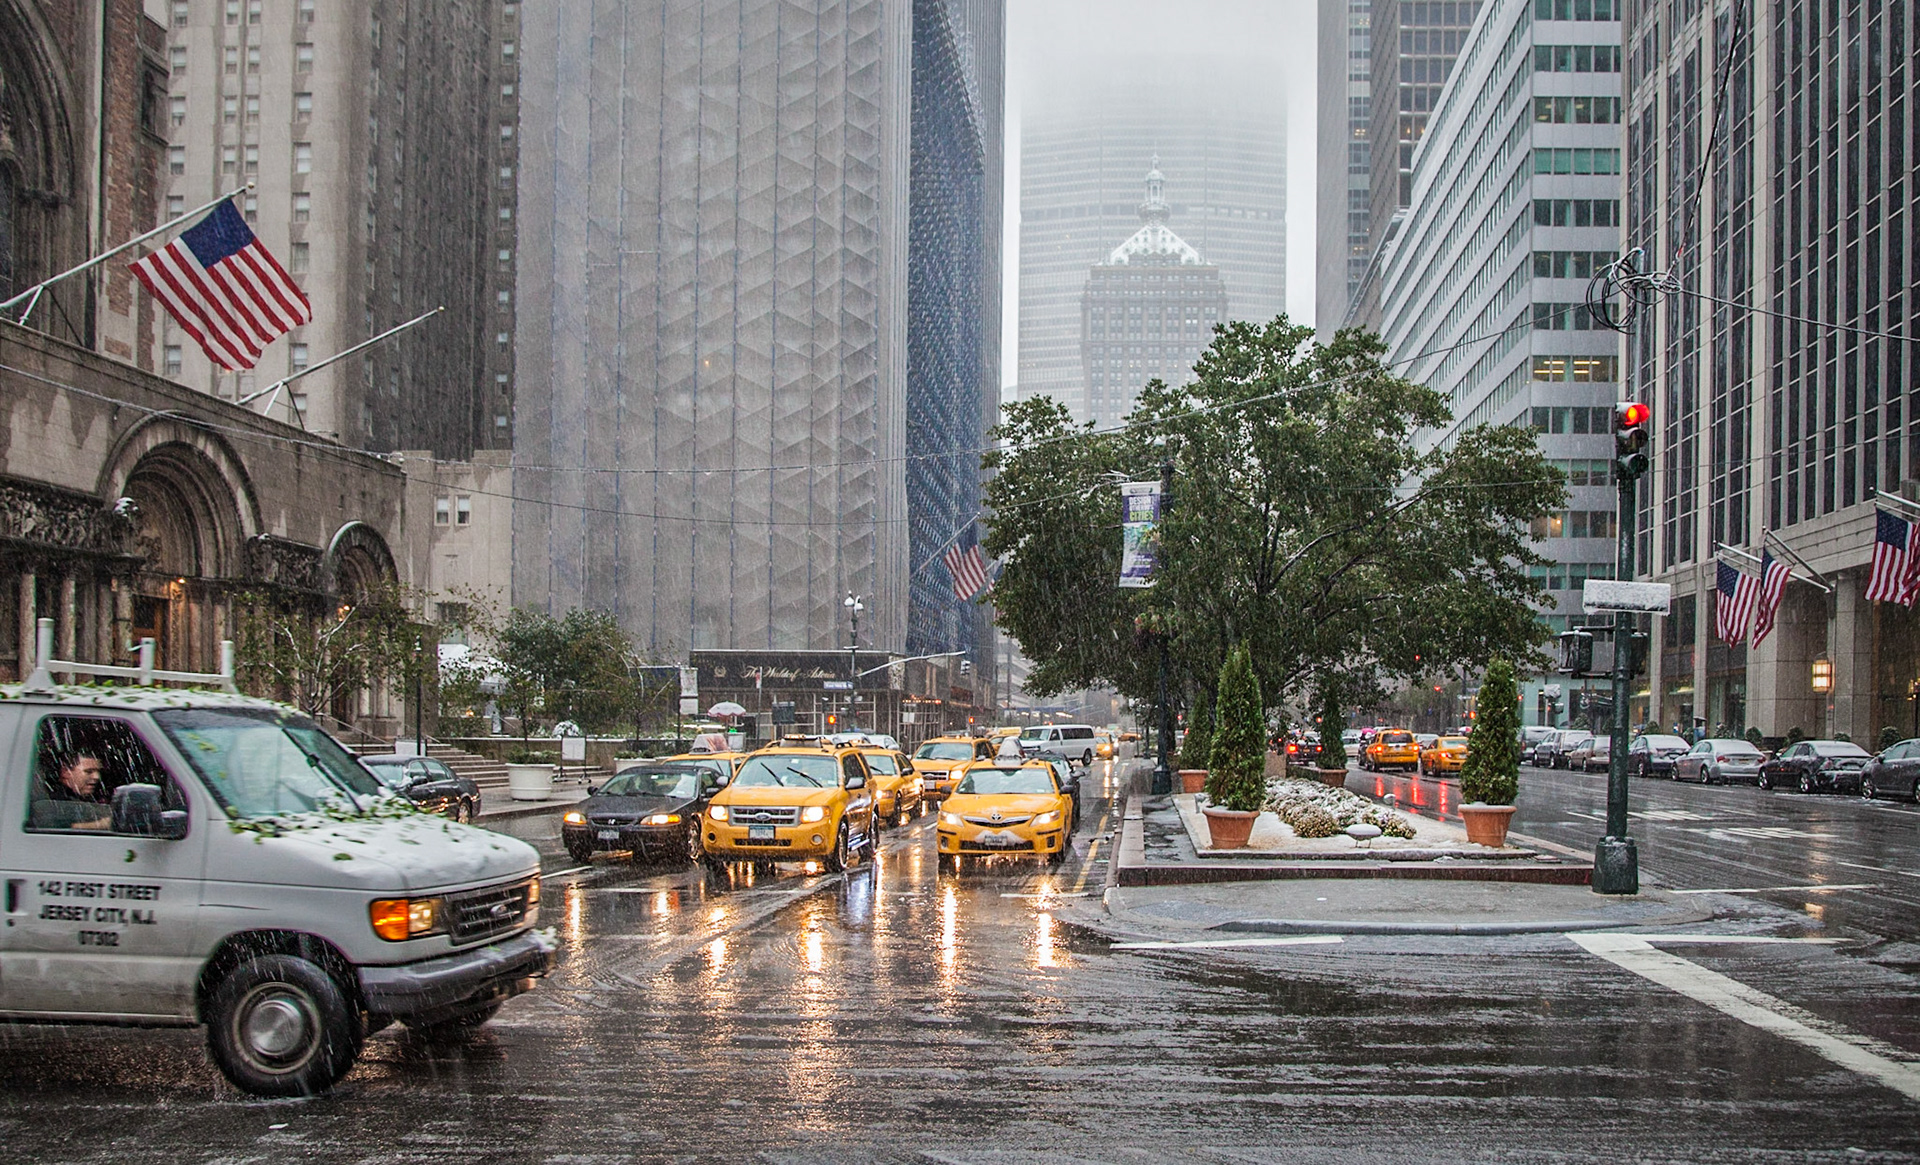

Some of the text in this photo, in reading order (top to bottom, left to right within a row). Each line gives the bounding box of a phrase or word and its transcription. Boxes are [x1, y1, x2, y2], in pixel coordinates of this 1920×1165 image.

[1129, 496, 1155, 505] DESIGN
[1130, 511, 1154, 521] CITIES
[740, 665, 759, 679] Th
[763, 666, 801, 683] Waldorf
[38, 880, 162, 901] 142 FIRST STREET
[39, 904, 158, 927] JERSEY CITY, N.J.
[79, 930, 119, 947] 07302
